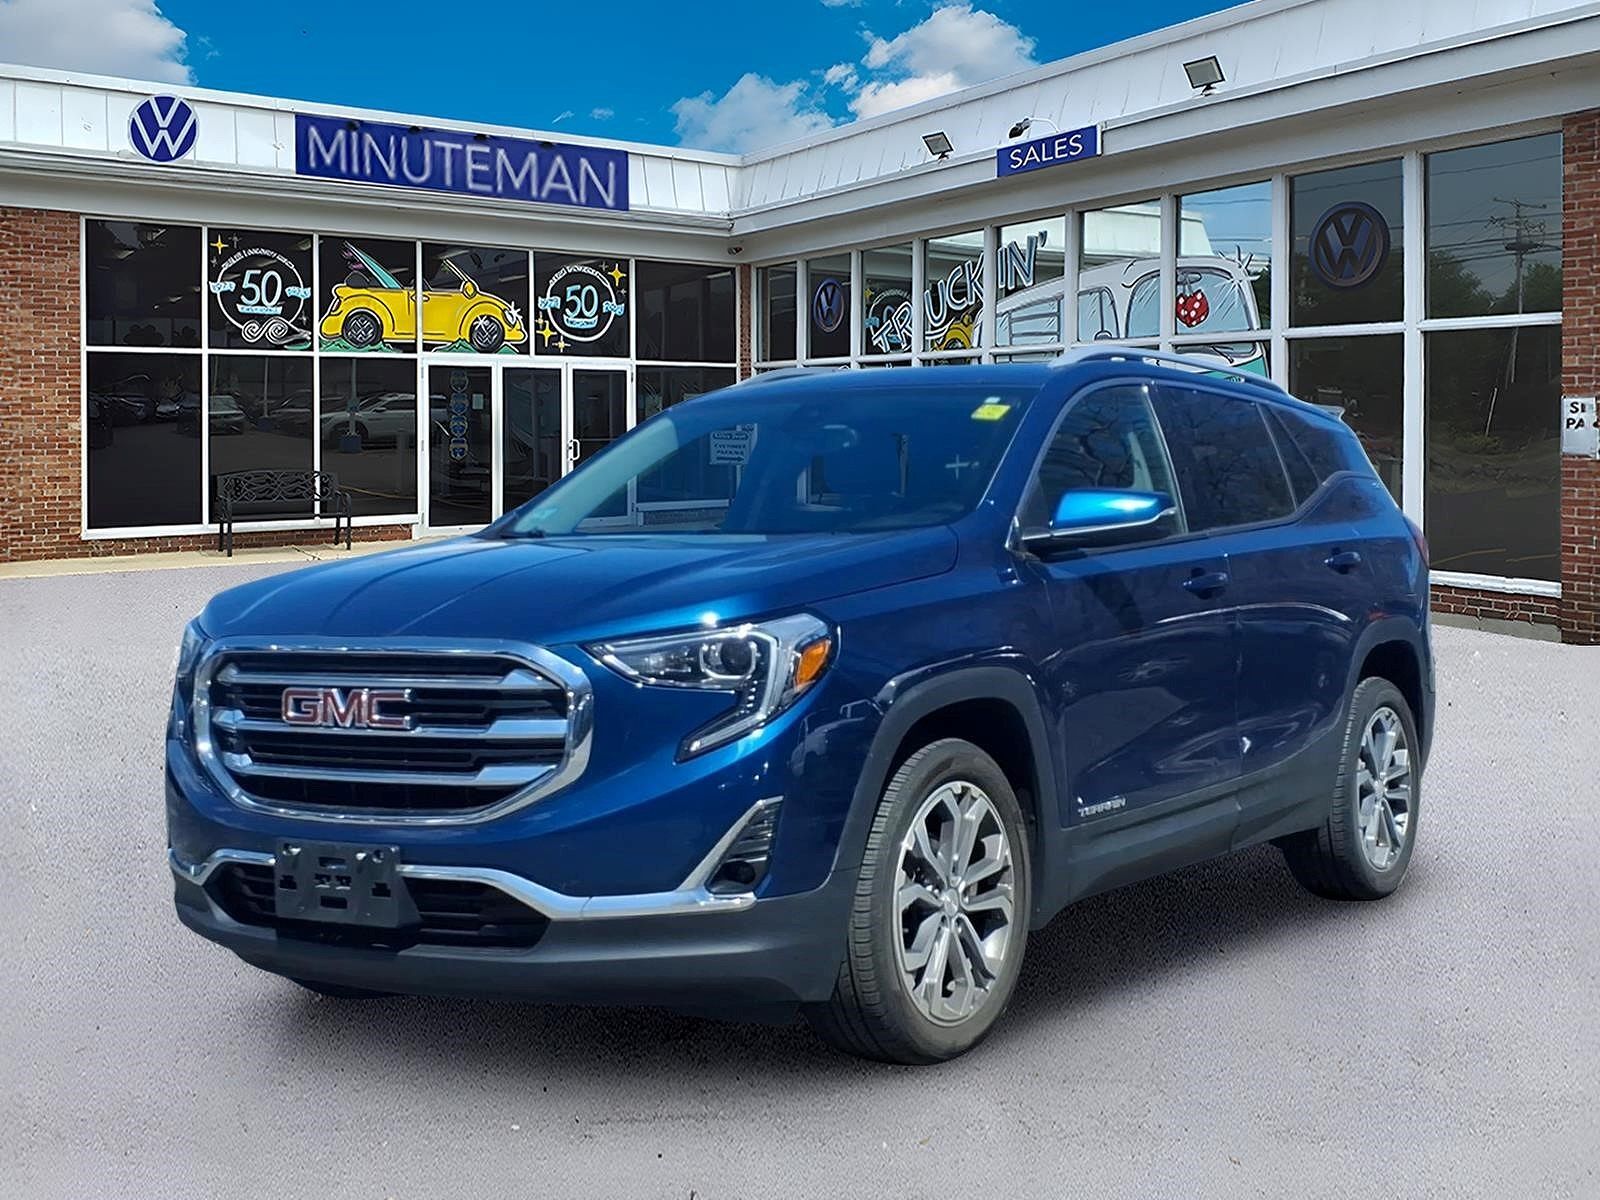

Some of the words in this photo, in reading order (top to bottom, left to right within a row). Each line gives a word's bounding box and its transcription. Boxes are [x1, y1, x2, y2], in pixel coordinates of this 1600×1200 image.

[306, 124, 616, 208] MINUTEMAN
[1009, 134, 1083, 169] SALES
[240, 269, 282, 307] 50
[564, 284, 598, 318] 50
[282, 687, 412, 730] GMC
